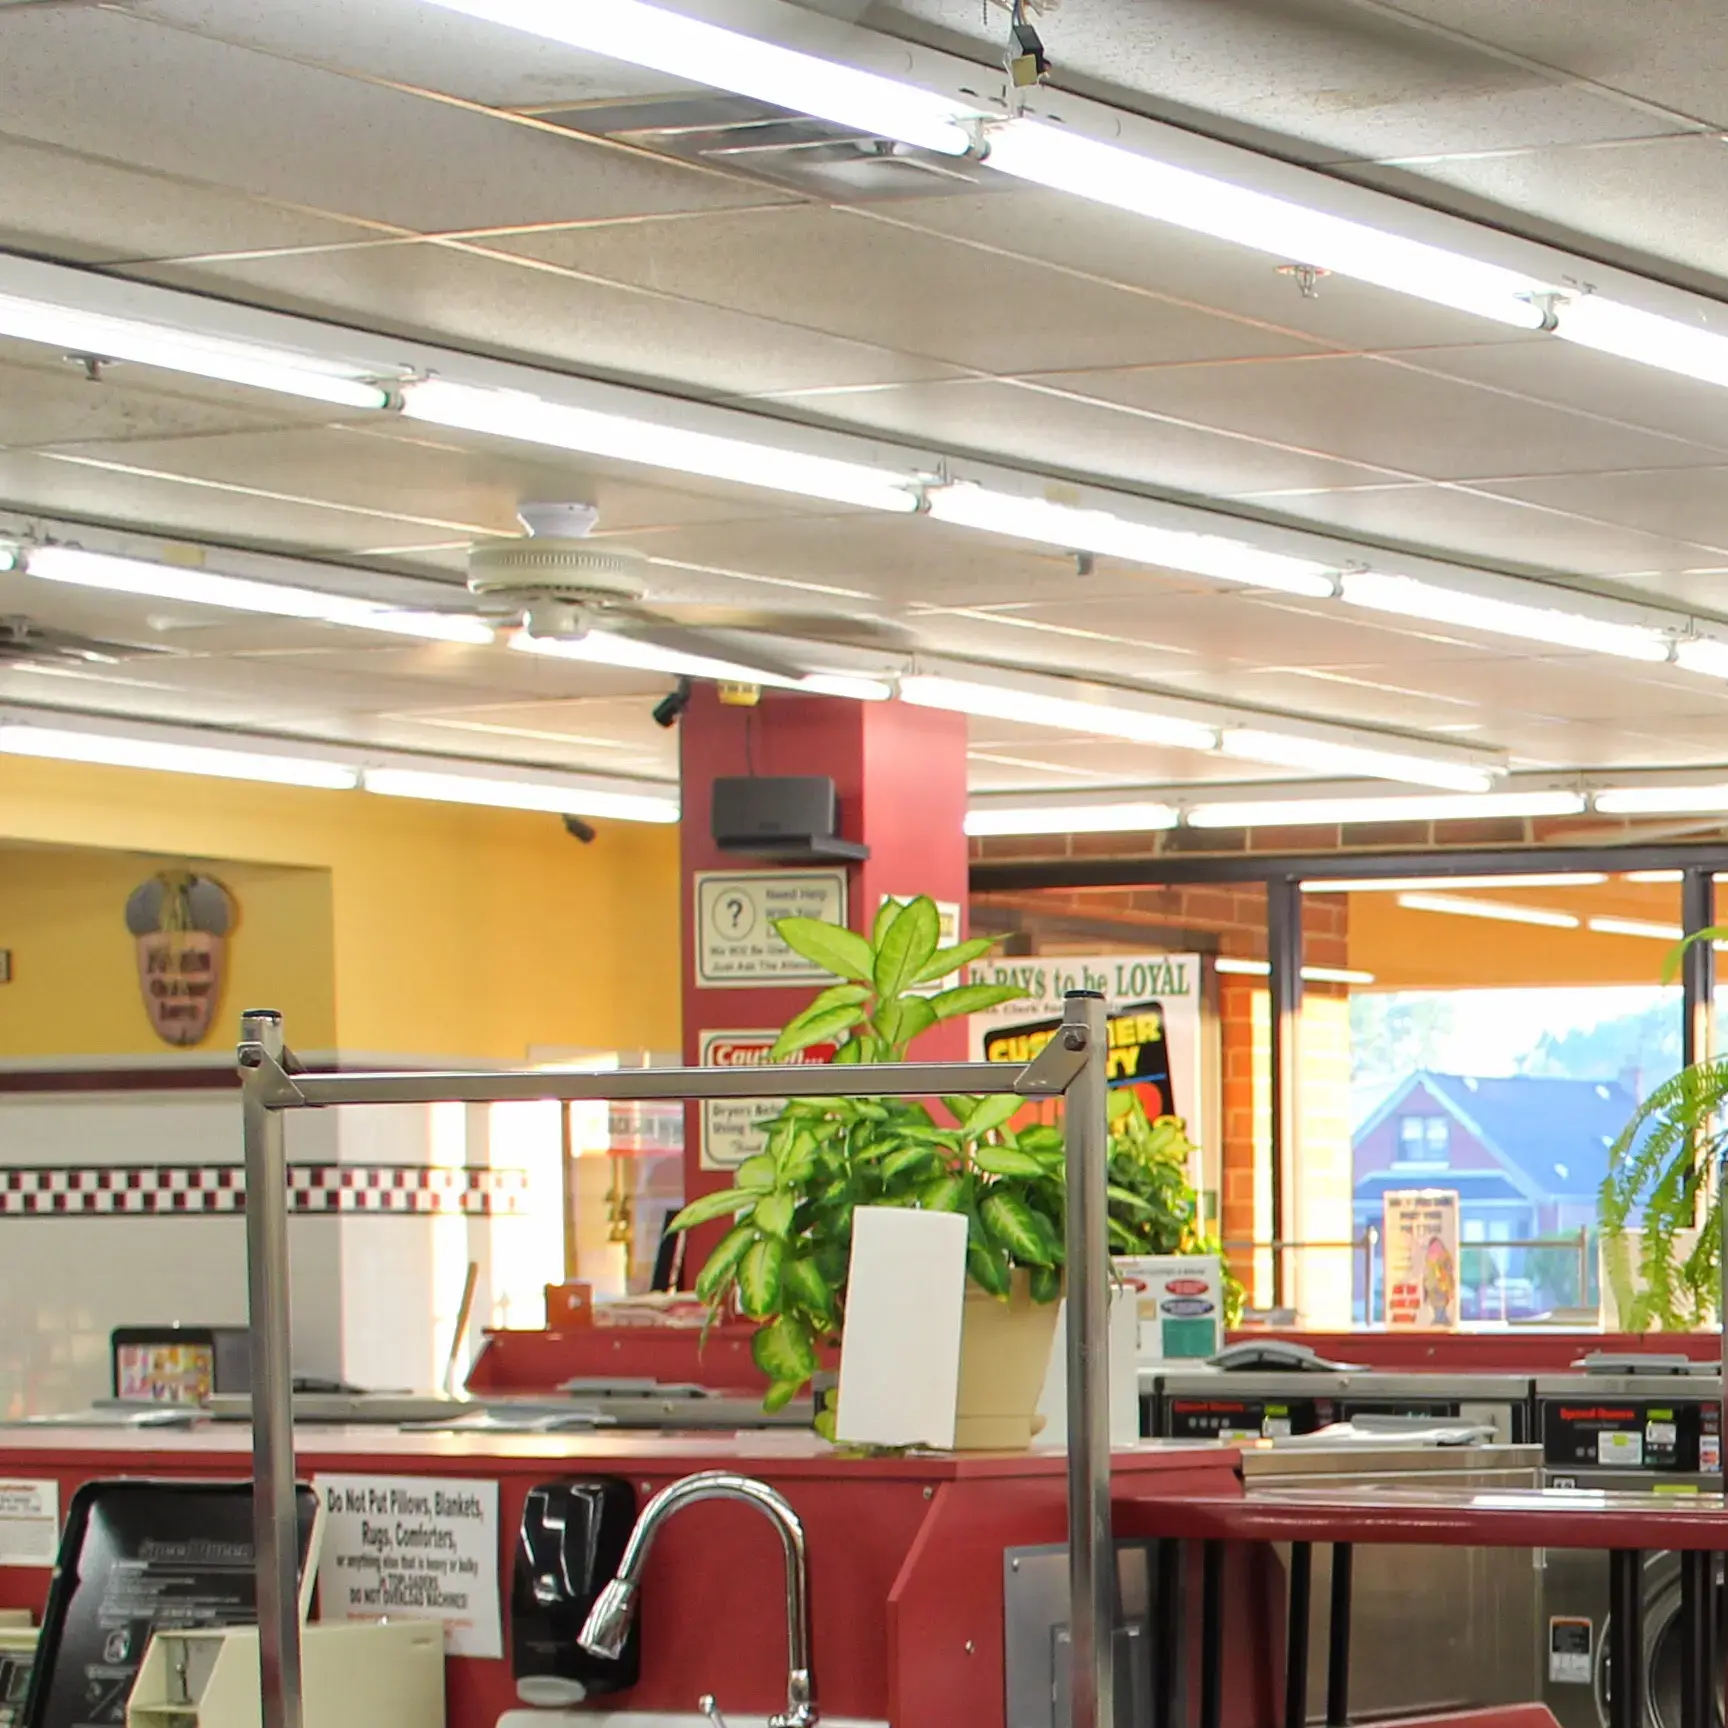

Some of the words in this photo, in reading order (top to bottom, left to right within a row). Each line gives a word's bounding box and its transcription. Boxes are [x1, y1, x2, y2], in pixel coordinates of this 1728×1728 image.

[1053, 967, 1076, 998] to
[1082, 965, 1109, 991] be
[1114, 961, 1191, 997] LOYAL
[327, 1487, 343, 1513] Do
[345, 1488, 366, 1514] Not
[368, 1488, 388, 1514] Put
[434, 1491, 484, 1524] Blankets,
[362, 1520, 393, 1552] Rugs,
[395, 1521, 457, 1553] Comforters,
